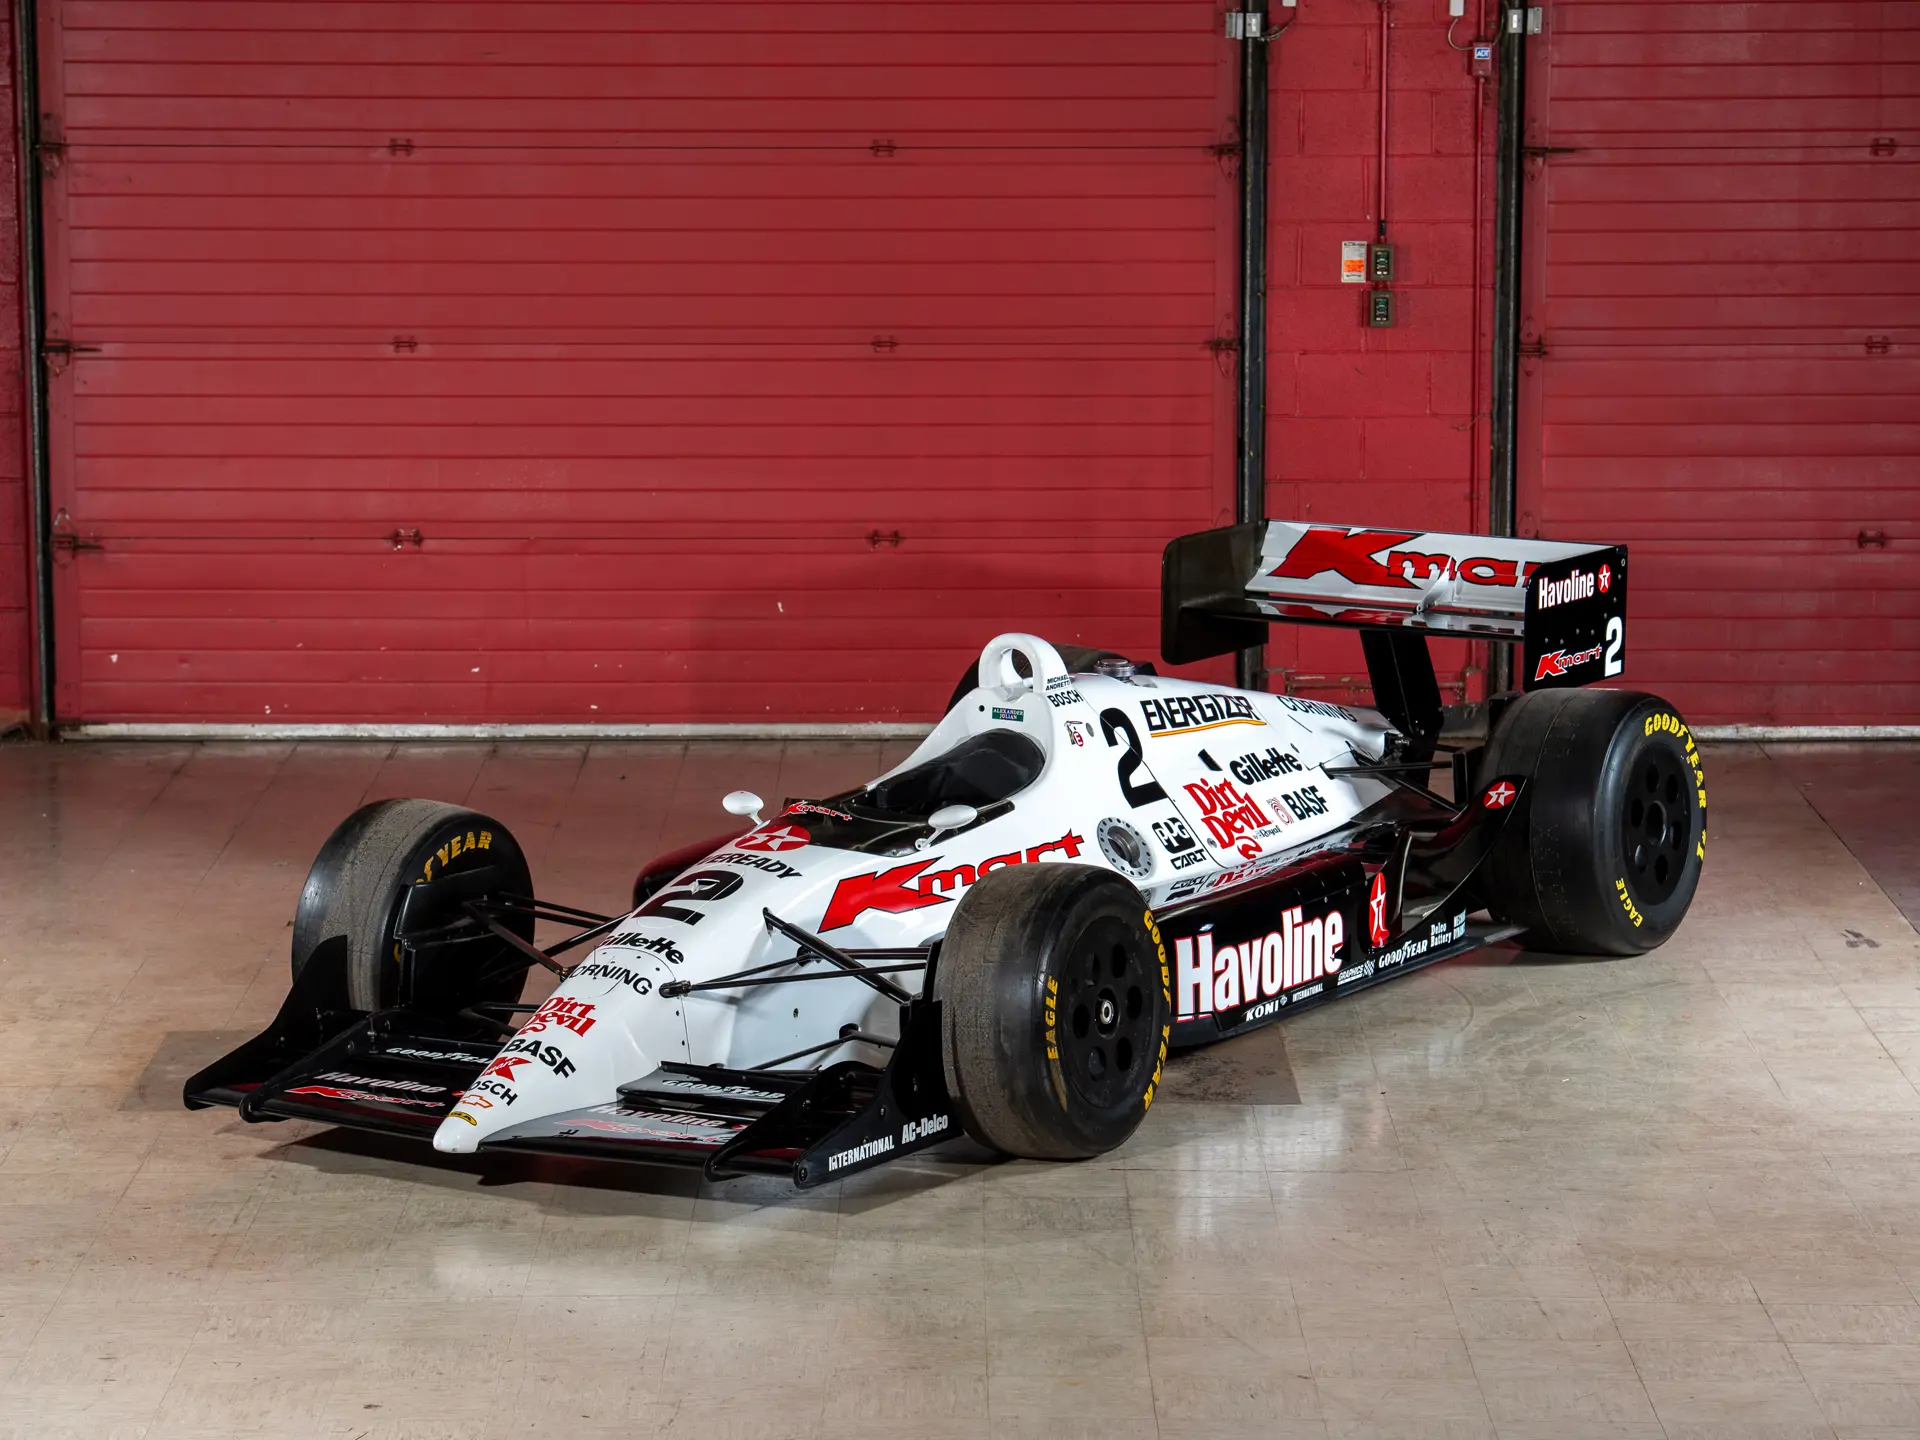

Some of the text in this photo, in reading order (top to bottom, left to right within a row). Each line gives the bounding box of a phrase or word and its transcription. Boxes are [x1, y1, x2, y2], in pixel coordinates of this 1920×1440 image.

[1476, 48, 1490, 57] ADT
[1268, 526, 1541, 590] Kmar
[1539, 569, 1595, 610] Havoline
[1604, 616, 1622, 677] 2
[1534, 643, 1602, 681] Kmart
[1047, 674, 1070, 684] MICHAEL
[993, 707, 1024, 715] ALEXANDER
[1047, 690, 1083, 707] BOSCH
[1140, 694, 1261, 731] ENERGIZER
[1276, 695, 1358, 722] CORNING
[999, 712, 1017, 720] JULIAN
[1100, 708, 1168, 809] 2
[1230, 747, 1302, 785] Gillette
[1645, 713, 1706, 808] GOODYEAR
[781, 800, 852, 821] Kmart
[1183, 778, 1245, 816] Dirt
[1281, 785, 1329, 820] BASF
[1154, 818, 1191, 848] PPG
[1201, 792, 1271, 849] Devil
[696, 853, 802, 879] VEREADY
[1170, 849, 1207, 870] CART
[818, 829, 1084, 932] Kmart
[631, 870, 744, 926] 2
[1616, 877, 1643, 928] EAGLE
[1430, 932, 1451, 947] Battery
[1431, 922, 1446, 935] Delco
[600, 932, 684, 964] illette
[1379, 940, 1428, 968] GOODYEAR
[1174, 905, 1343, 1023] Havoline
[569, 964, 652, 995] ORNING
[1292, 983, 1323, 1002] INTERNATIONAL
[539, 997, 596, 1018] Dirt
[1045, 975, 1058, 1060] EAGLE
[1144, 910, 1171, 1110] GOODYEAR
[1246, 1000, 1279, 1021] KONI
[386, 1047, 492, 1064] GOODYEA
[502, 1039, 576, 1078] BASF
[284, 1085, 446, 1108] Kmart
[314, 1072, 447, 1094] Havoline
[470, 1080, 518, 1106] OSCH
[662, 1080, 785, 1099] GOODYEAR
[587, 1104, 726, 1127] Havoline
[902, 1114, 948, 1144] AC-Delco
[828, 1135, 895, 1171] INTERNATIONAL
